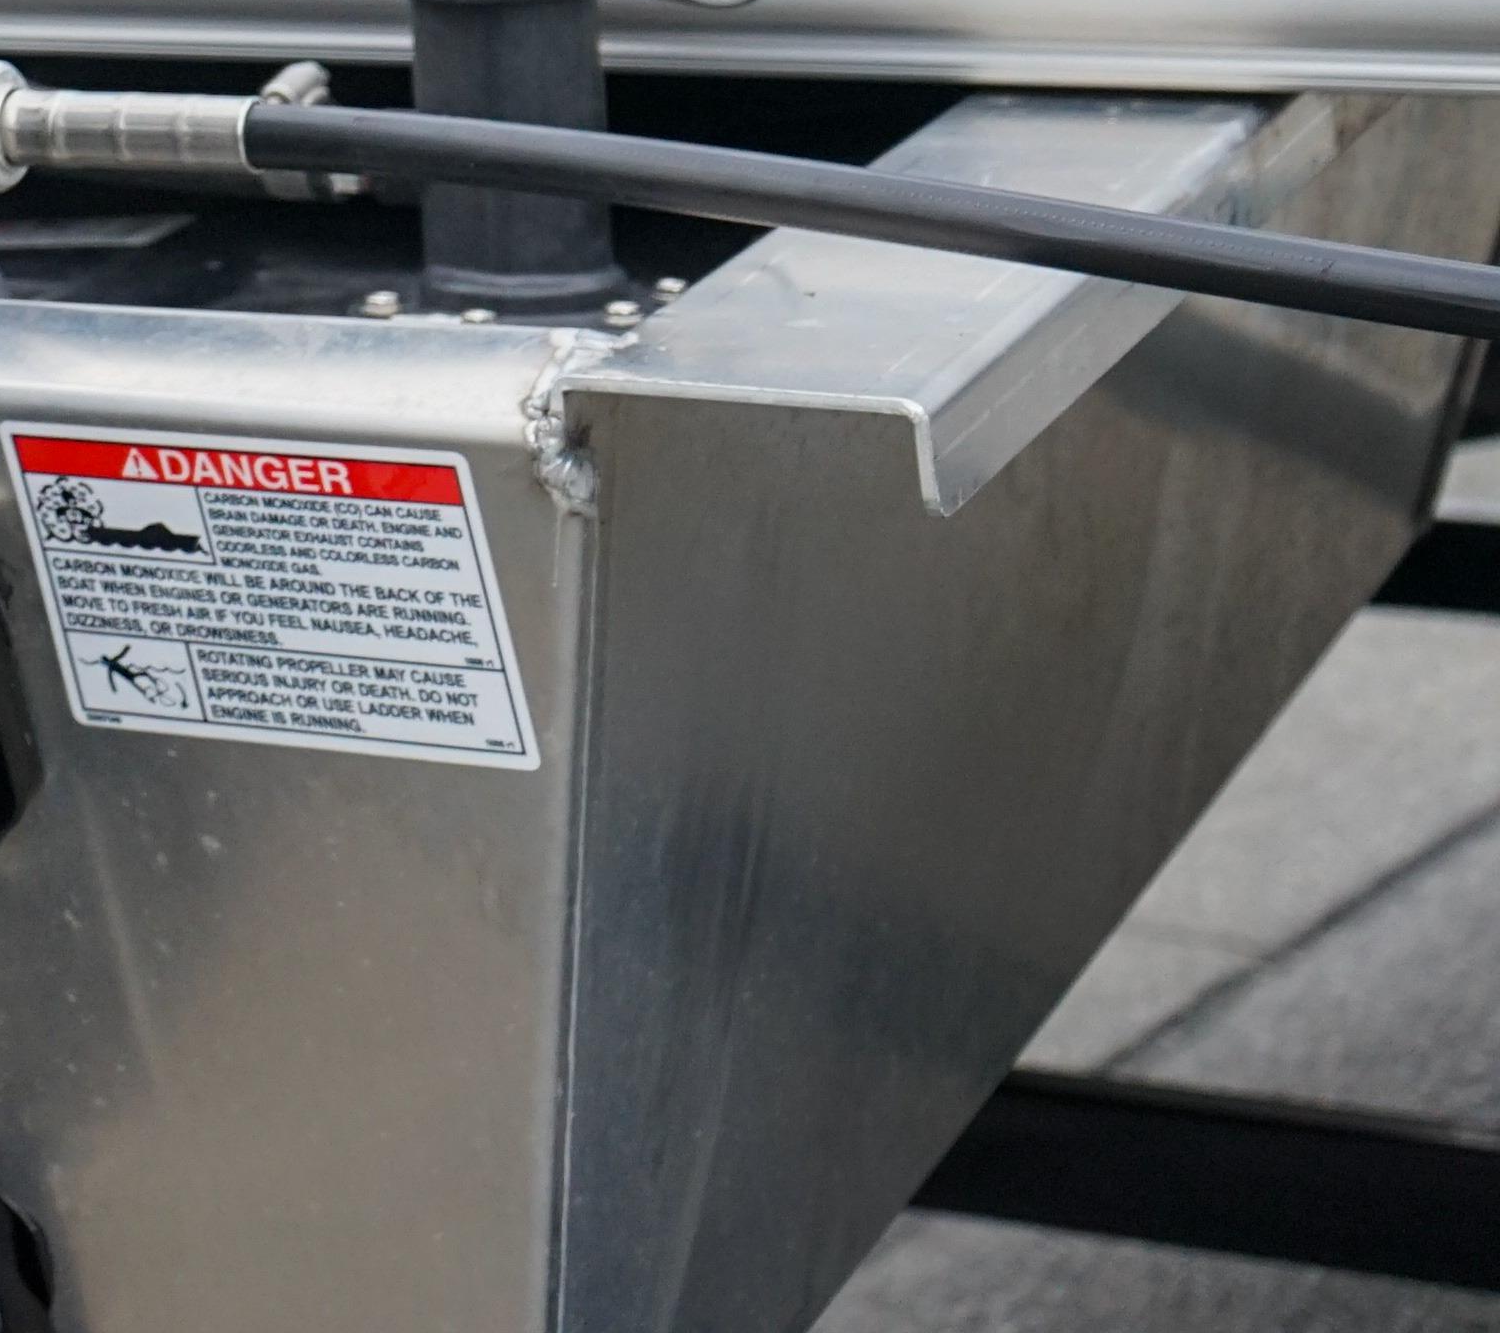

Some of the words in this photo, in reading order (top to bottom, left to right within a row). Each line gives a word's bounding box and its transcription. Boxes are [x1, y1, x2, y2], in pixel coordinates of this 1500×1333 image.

[159, 448, 353, 495] DANGER
[204, 493, 259, 507] CARBON
[262, 497, 330, 512] MONOXIDE
[334, 502, 362, 517] (CO)
[366, 505, 392, 517] CAN
[395, 507, 442, 522] CAUSE
[209, 509, 247, 522] BRAIN
[251, 513, 308, 527] DAMAGE
[310, 517, 329, 528] OR
[333, 519, 379, 532] DEATH.
[382, 523, 431, 536] ENGINE
[435, 527, 462, 539] AND
[213, 525, 291, 541] GENERATOR
[294, 532, 354, 546] EXHAUST
[358, 536, 424, 552] CONTAINS
[216, 541, 287, 556] ODORLESS
[290, 547, 316, 559] AND
[320, 549, 399, 566] COLORLESS
[402, 556, 460, 571] CARBON
[52, 557, 116, 574] CARBON
[120, 564, 201, 583] MONOXIDE
[204, 572, 242, 587] WILL
[244, 576, 265, 589] BE
[269, 578, 335, 596] AROUND
[338, 583, 371, 599] THE
[374, 587, 421, 603] BACK
[424, 591, 445, 604] OF
[449, 592, 483, 608] THE
[220, 557, 289, 572] MONOXIDE
[58, 576, 96, 590] BOAT
[100, 580, 146, 596] WHEN
[149, 585, 216, 603] ENGINES
[220, 592, 243, 605] OR
[247, 594, 353, 616] GENERATORS
[357, 604, 389, 619] ARE
[393, 607, 472, 626] RUNNING.
[61, 595, 105, 611] MOVE
[107, 599, 129, 612] TO
[131, 601, 183, 617] FRESH
[187, 606, 212, 620] AIR
[214, 609, 230, 621] IF
[232, 609, 265, 625] YOU
[268, 614, 307, 630] FEEL
[311, 618, 381, 639] NAUSEA,
[384, 626, 479, 647] HEADACHE,
[66, 612, 147, 635] DIZZINESS,
[149, 620, 172, 634] OR
[176, 622, 282, 646] DROWSINESS.
[196, 649, 273, 669] ROTATING
[277, 658, 371, 678] PROPELLER
[374, 668, 408, 682] MAY
[411, 670, 467, 688] CAUSE
[201, 669, 269, 686] SERIOUS
[273, 676, 328, 693] INJURY
[331, 682, 356, 695] OR
[358, 684, 416, 701] DEATH.
[418, 690, 444, 704] DO
[446, 692, 479, 707] NOT
[207, 688, 293, 707] APPROACH
[296, 695, 321, 709] OR
[323, 697, 355, 712] USE
[358, 701, 423, 720] LADDER
[426, 708, 476, 726] WHEN
[211, 706, 269, 722] ENGINE
[272, 711, 287, 724] IS
[290, 712, 366, 733] RUNNING.
